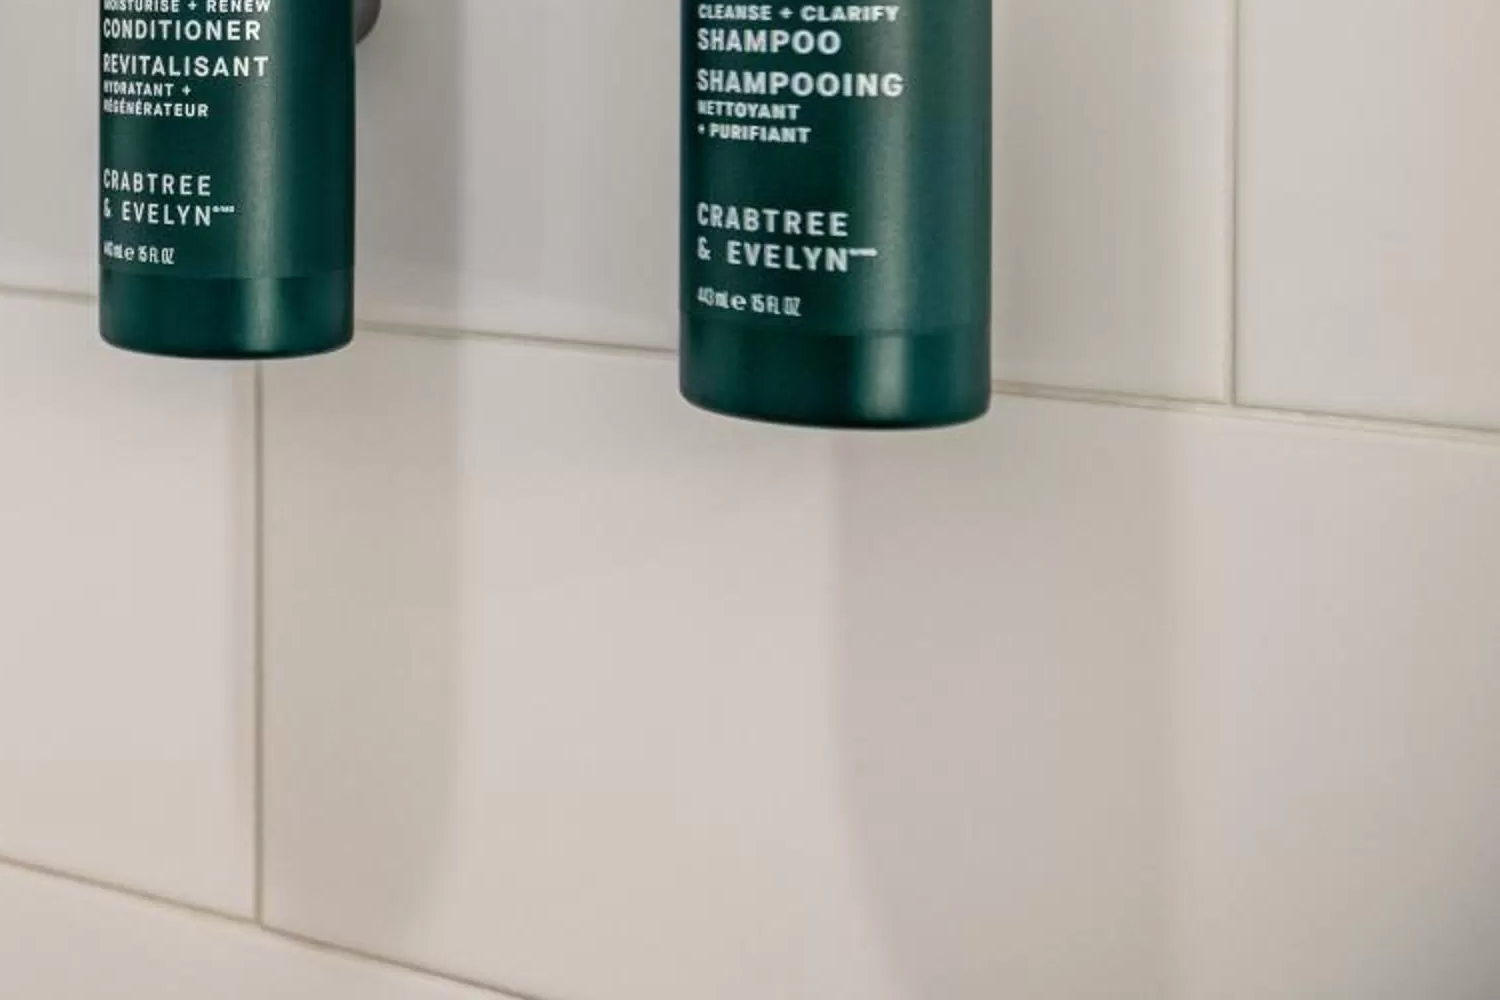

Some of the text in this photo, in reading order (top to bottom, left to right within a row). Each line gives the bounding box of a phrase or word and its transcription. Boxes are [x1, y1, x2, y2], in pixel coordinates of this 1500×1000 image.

[698, 3, 772, 21] CLEANSE
[800, 4, 900, 22] CLARIFY
[103, 18, 262, 41] CONDITIONER
[697, 27, 842, 55] SHAMPOO
[103, 53, 269, 77] REVITALISANT
[103, 79, 174, 97] HYDRATANT
[696, 68, 904, 97] SHAMPOOING
[103, 97, 209, 117] RÉGÉNÉRATEUR
[697, 99, 800, 121] NETTOYANT
[709, 122, 812, 144] PURIFIANT
[103, 168, 212, 197] CRABTREE
[121, 200, 212, 227] EVELYN
[697, 201, 849, 238] CRABTREE
[697, 236, 848, 273] & EVELYN
